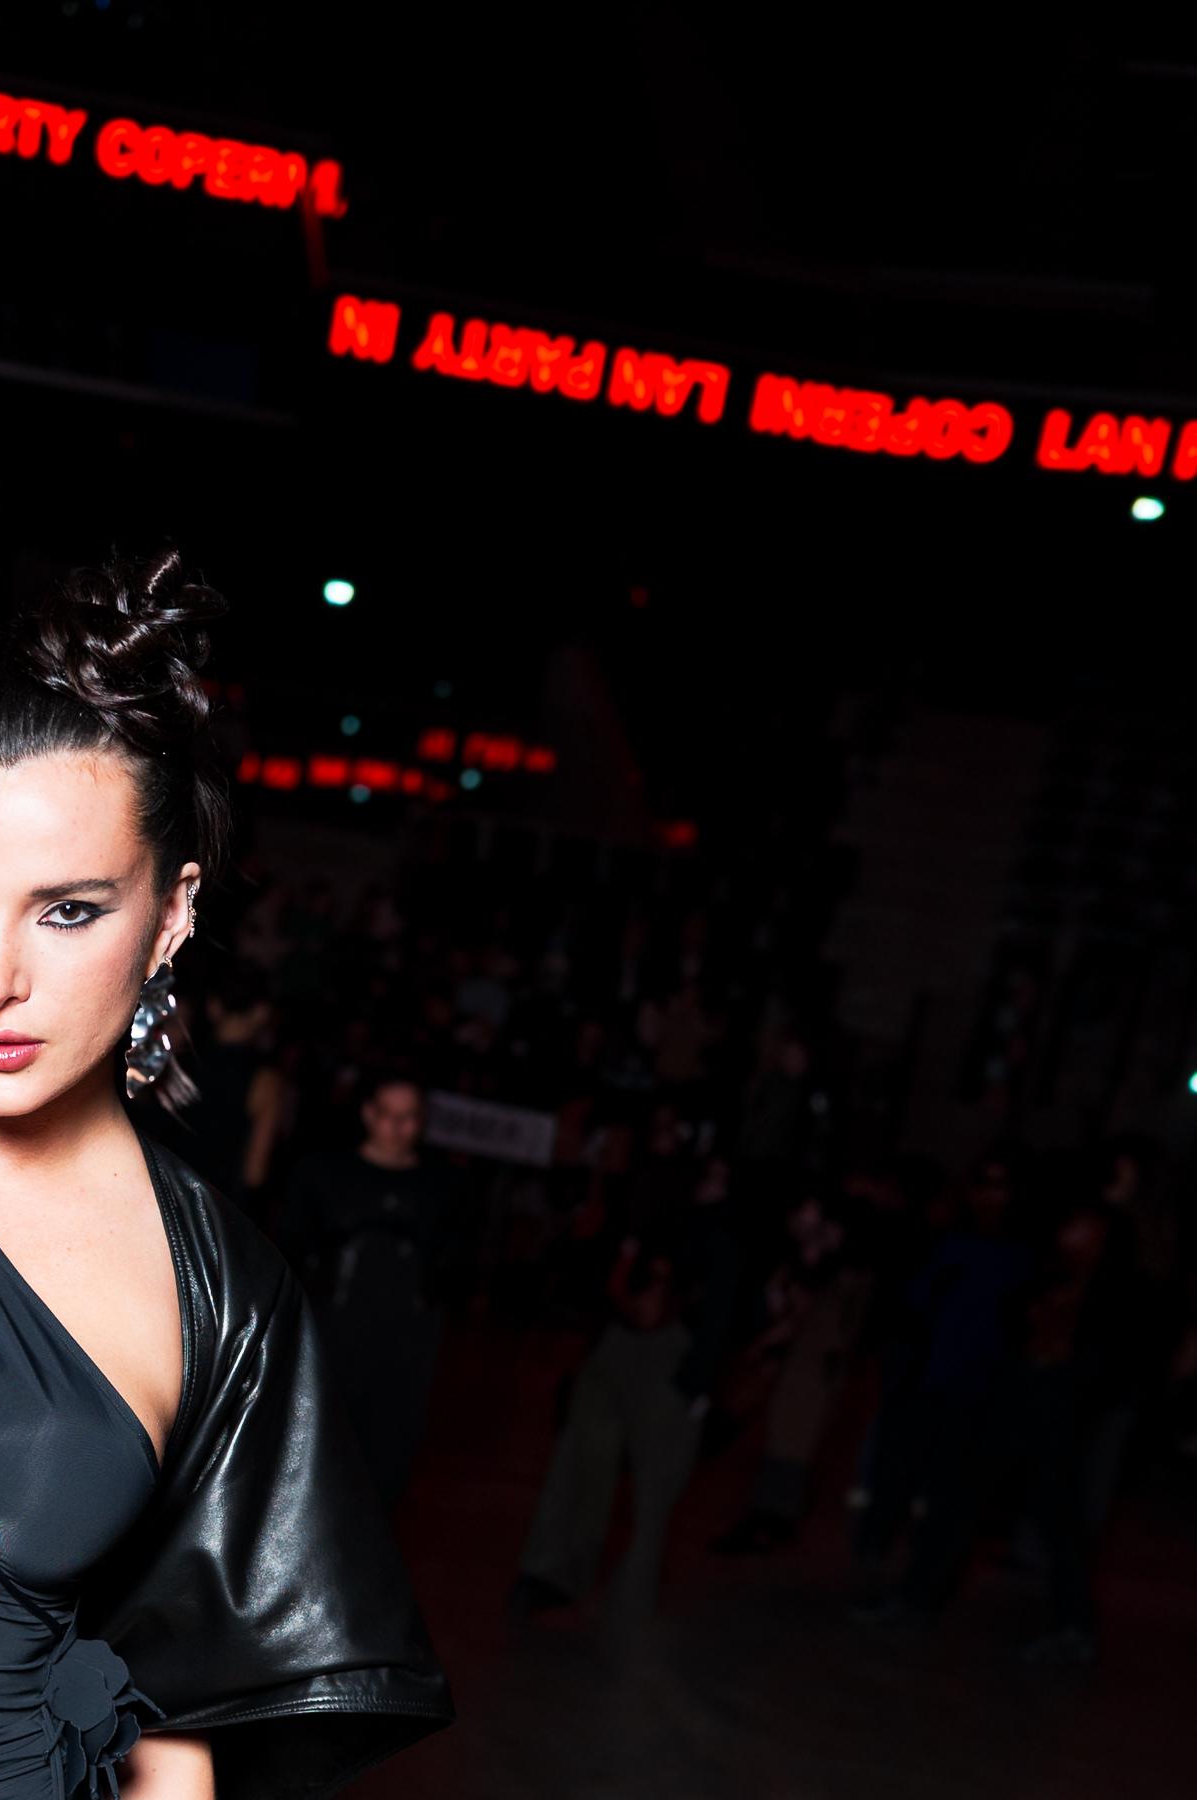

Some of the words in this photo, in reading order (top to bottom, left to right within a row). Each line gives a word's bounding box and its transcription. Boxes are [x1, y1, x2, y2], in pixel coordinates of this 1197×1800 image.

[412, 312, 607, 401] PARTY
[608, 347, 732, 424] LAN
[1036, 408, 1172, 478] LAN
